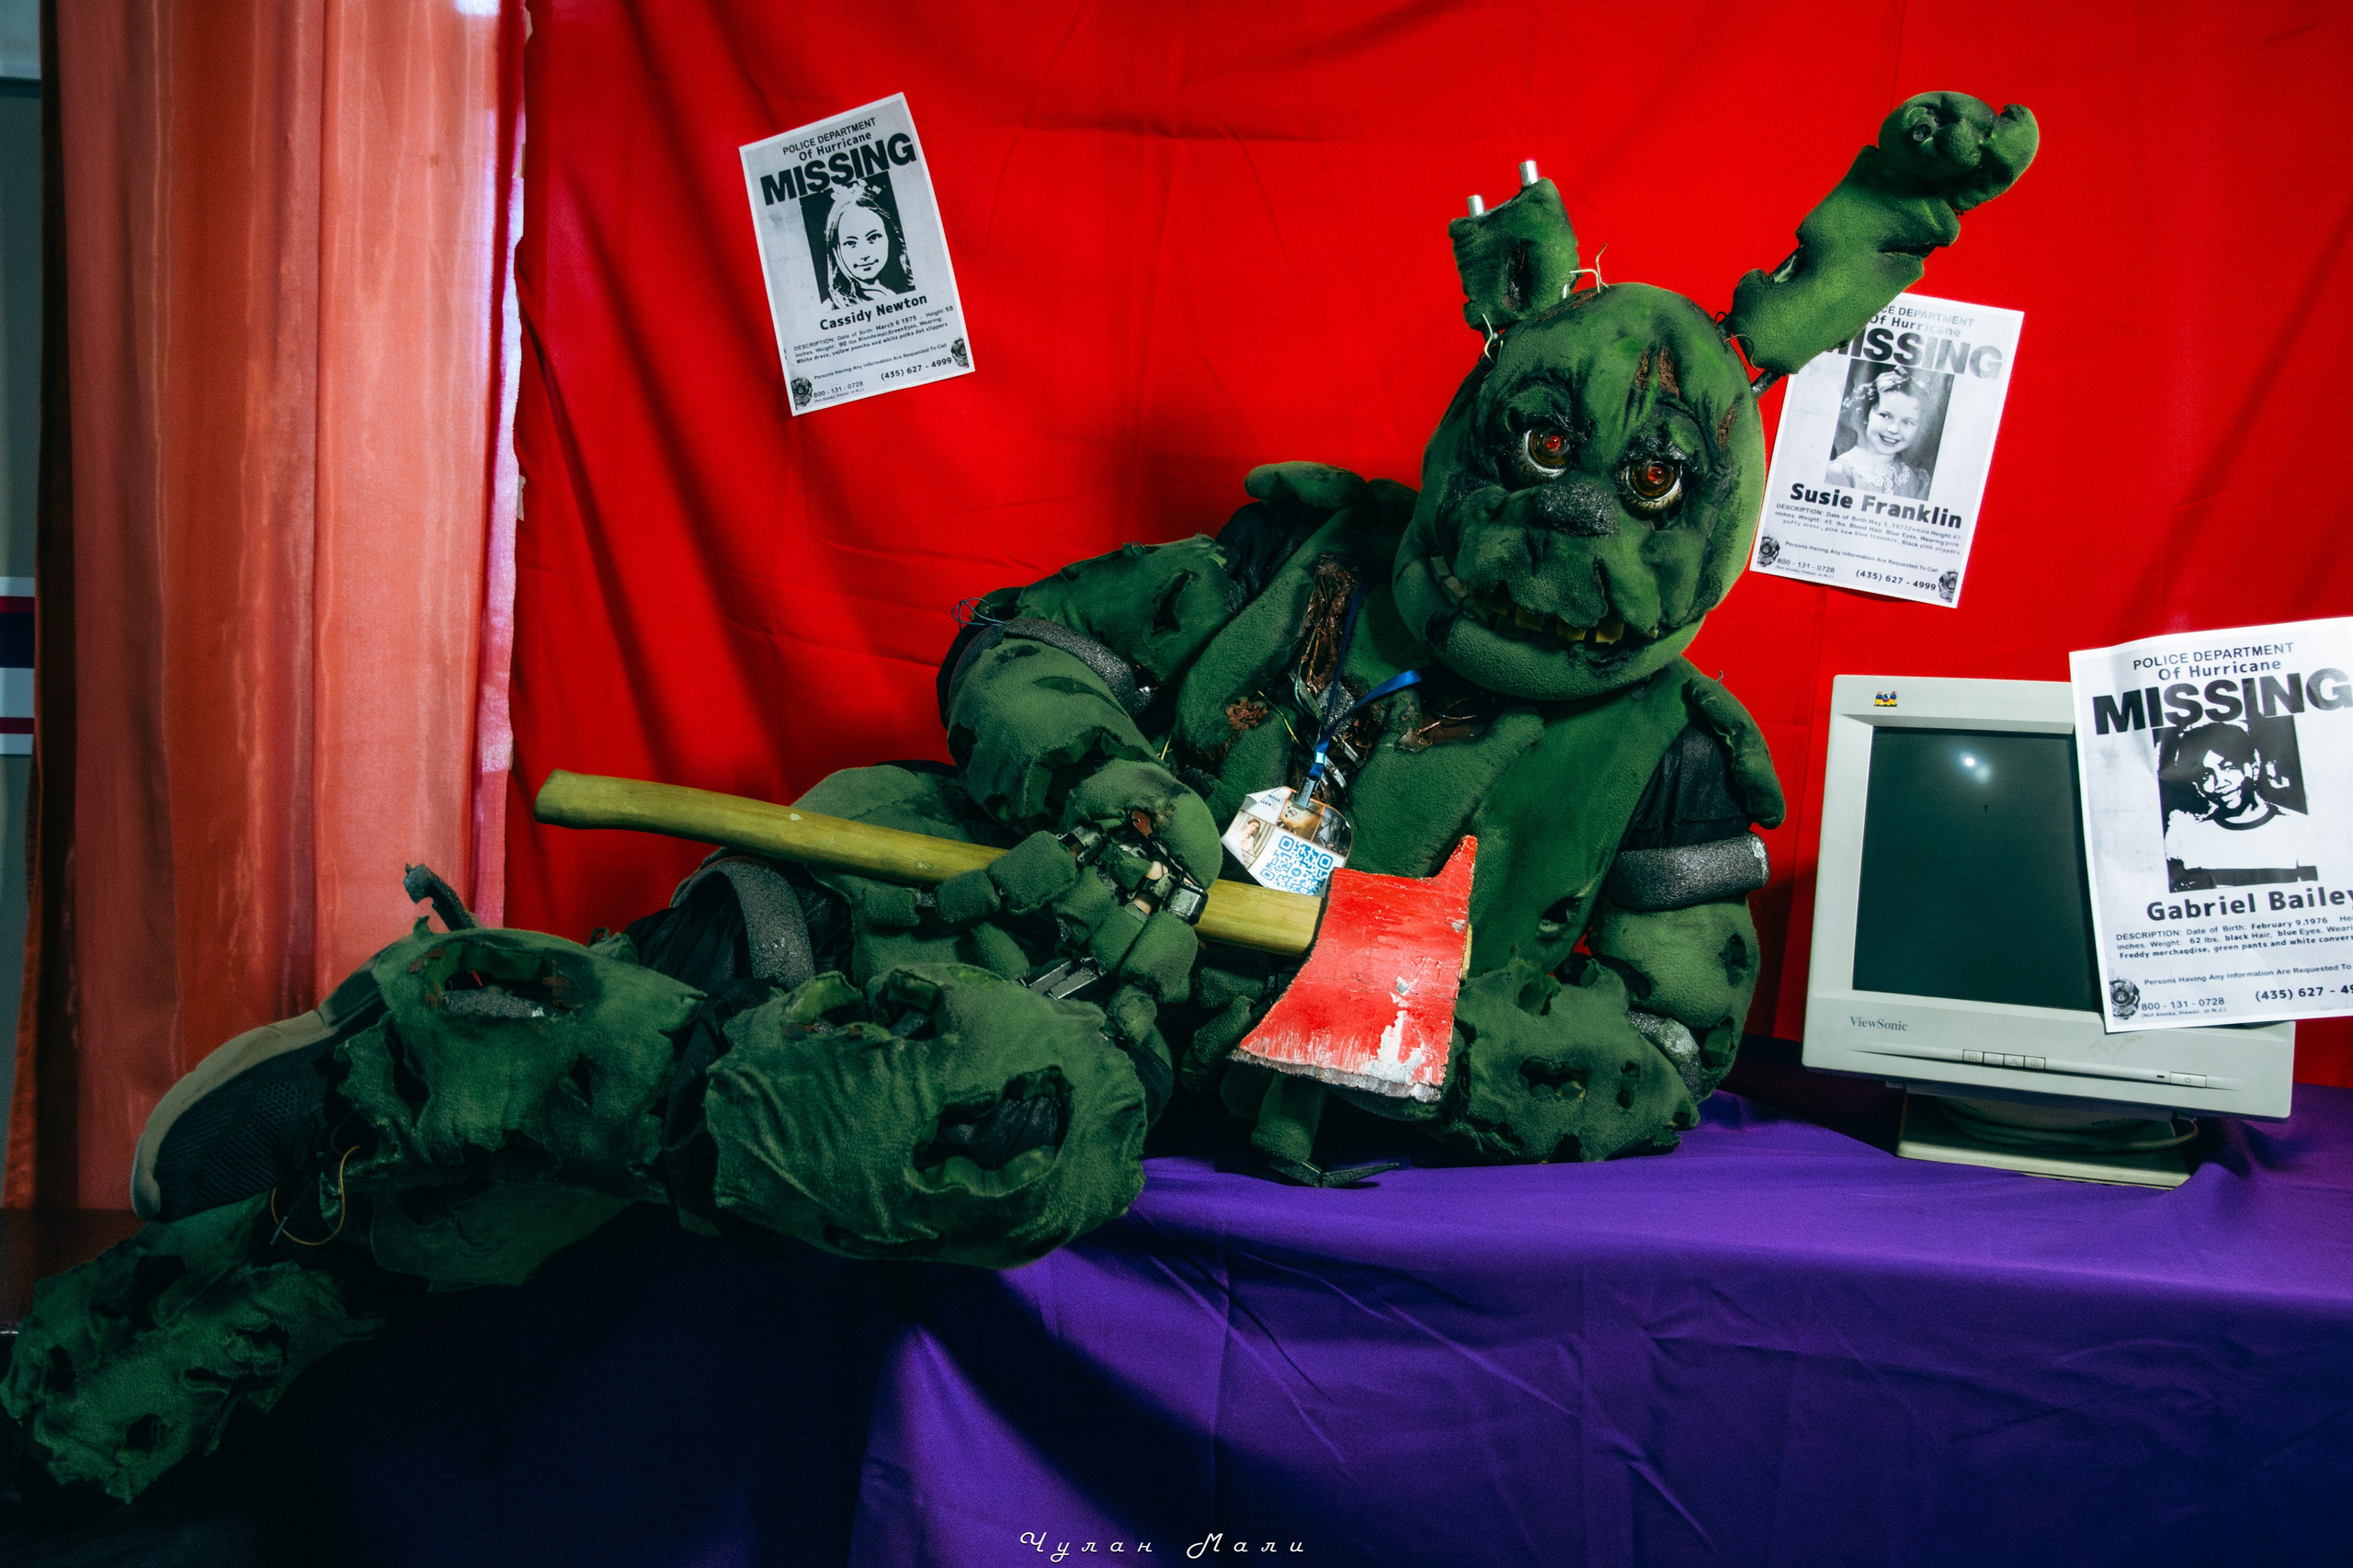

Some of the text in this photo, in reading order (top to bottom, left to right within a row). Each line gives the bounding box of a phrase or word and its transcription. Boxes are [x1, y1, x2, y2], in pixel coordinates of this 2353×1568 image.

[782, 117, 875, 155] POLICE DEPARTMENT
[798, 131, 871, 161] Of Hurricane
[759, 132, 917, 206] MISSING
[819, 295, 927, 330] Cassidy Newton
[875, 322, 894, 331] March
[901, 314, 916, 324] 1975
[1898, 306, 1975, 327] DEPARTMENT
[926, 323, 948, 332] slippers
[1869, 312, 1961, 337] Of Hurricane
[1825, 327, 2003, 380] ISSING
[813, 371, 834, 380] Persons
[834, 367, 852, 375] Having
[881, 357, 952, 381] (435) 627 4999
[813, 390, 825, 398] 800
[847, 381, 864, 389] 0728
[1790, 483, 1961, 528] Susie Franklin
[1869, 518, 1881, 527] May
[1784, 540, 1808, 549] Persons
[1809, 545, 1829, 554] Having
[1777, 557, 1790, 565] 800
[1816, 564, 1835, 574] 0728
[1856, 569, 1936, 590] (435) 627 4999
[2132, 642, 2292, 670] POLICE DEPARTMENT
[2157, 660, 2280, 680] Of Hurricane
[2092, 668, 2353, 735] MISSING
[2146, 892, 2256, 921] Gabriel
[2212, 944, 2239, 953] green
[2241, 941, 2268, 950] pants
[2224, 933, 2248, 941] black
[2226, 970, 2274, 978] Information
[2292, 964, 2339, 973] Requested
[2141, 996, 2225, 1011] 800 131 0728
[2255, 988, 2293, 1002] (435)
[2298, 986, 2324, 997] 627
[1849, 1016, 1908, 1031] ViewSonic
